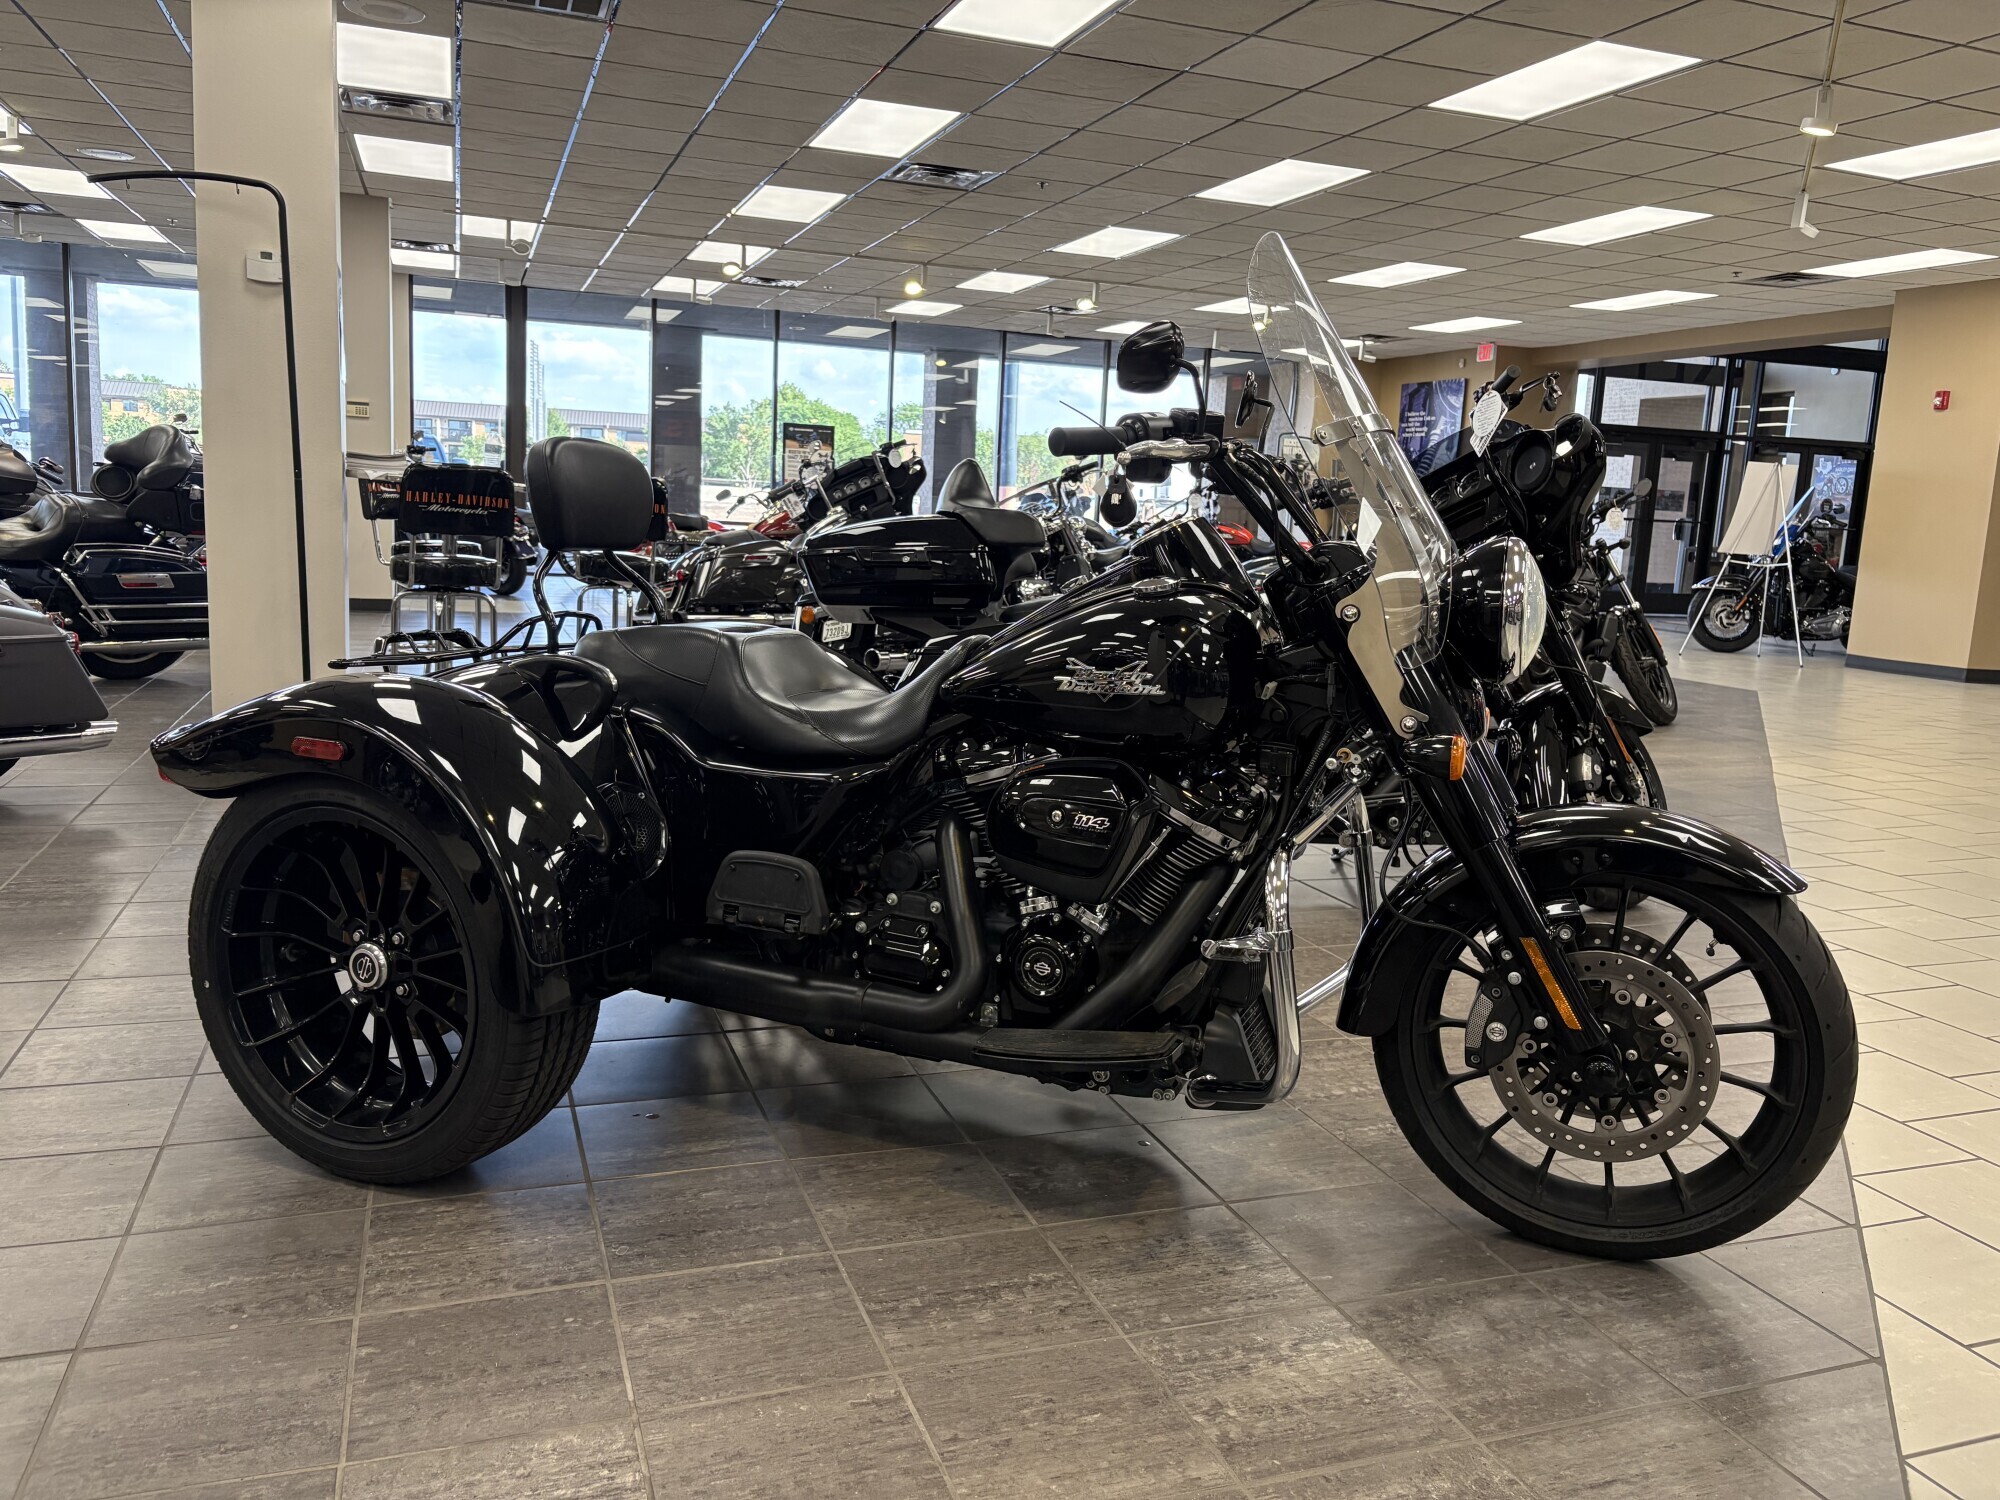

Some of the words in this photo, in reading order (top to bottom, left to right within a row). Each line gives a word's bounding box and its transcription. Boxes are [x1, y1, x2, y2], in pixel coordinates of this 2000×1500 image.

[406, 490, 510, 509] HARLEY-DAVIDSON
[422, 504, 489, 515] Motorcycles
[1073, 814, 1111, 829] 114
